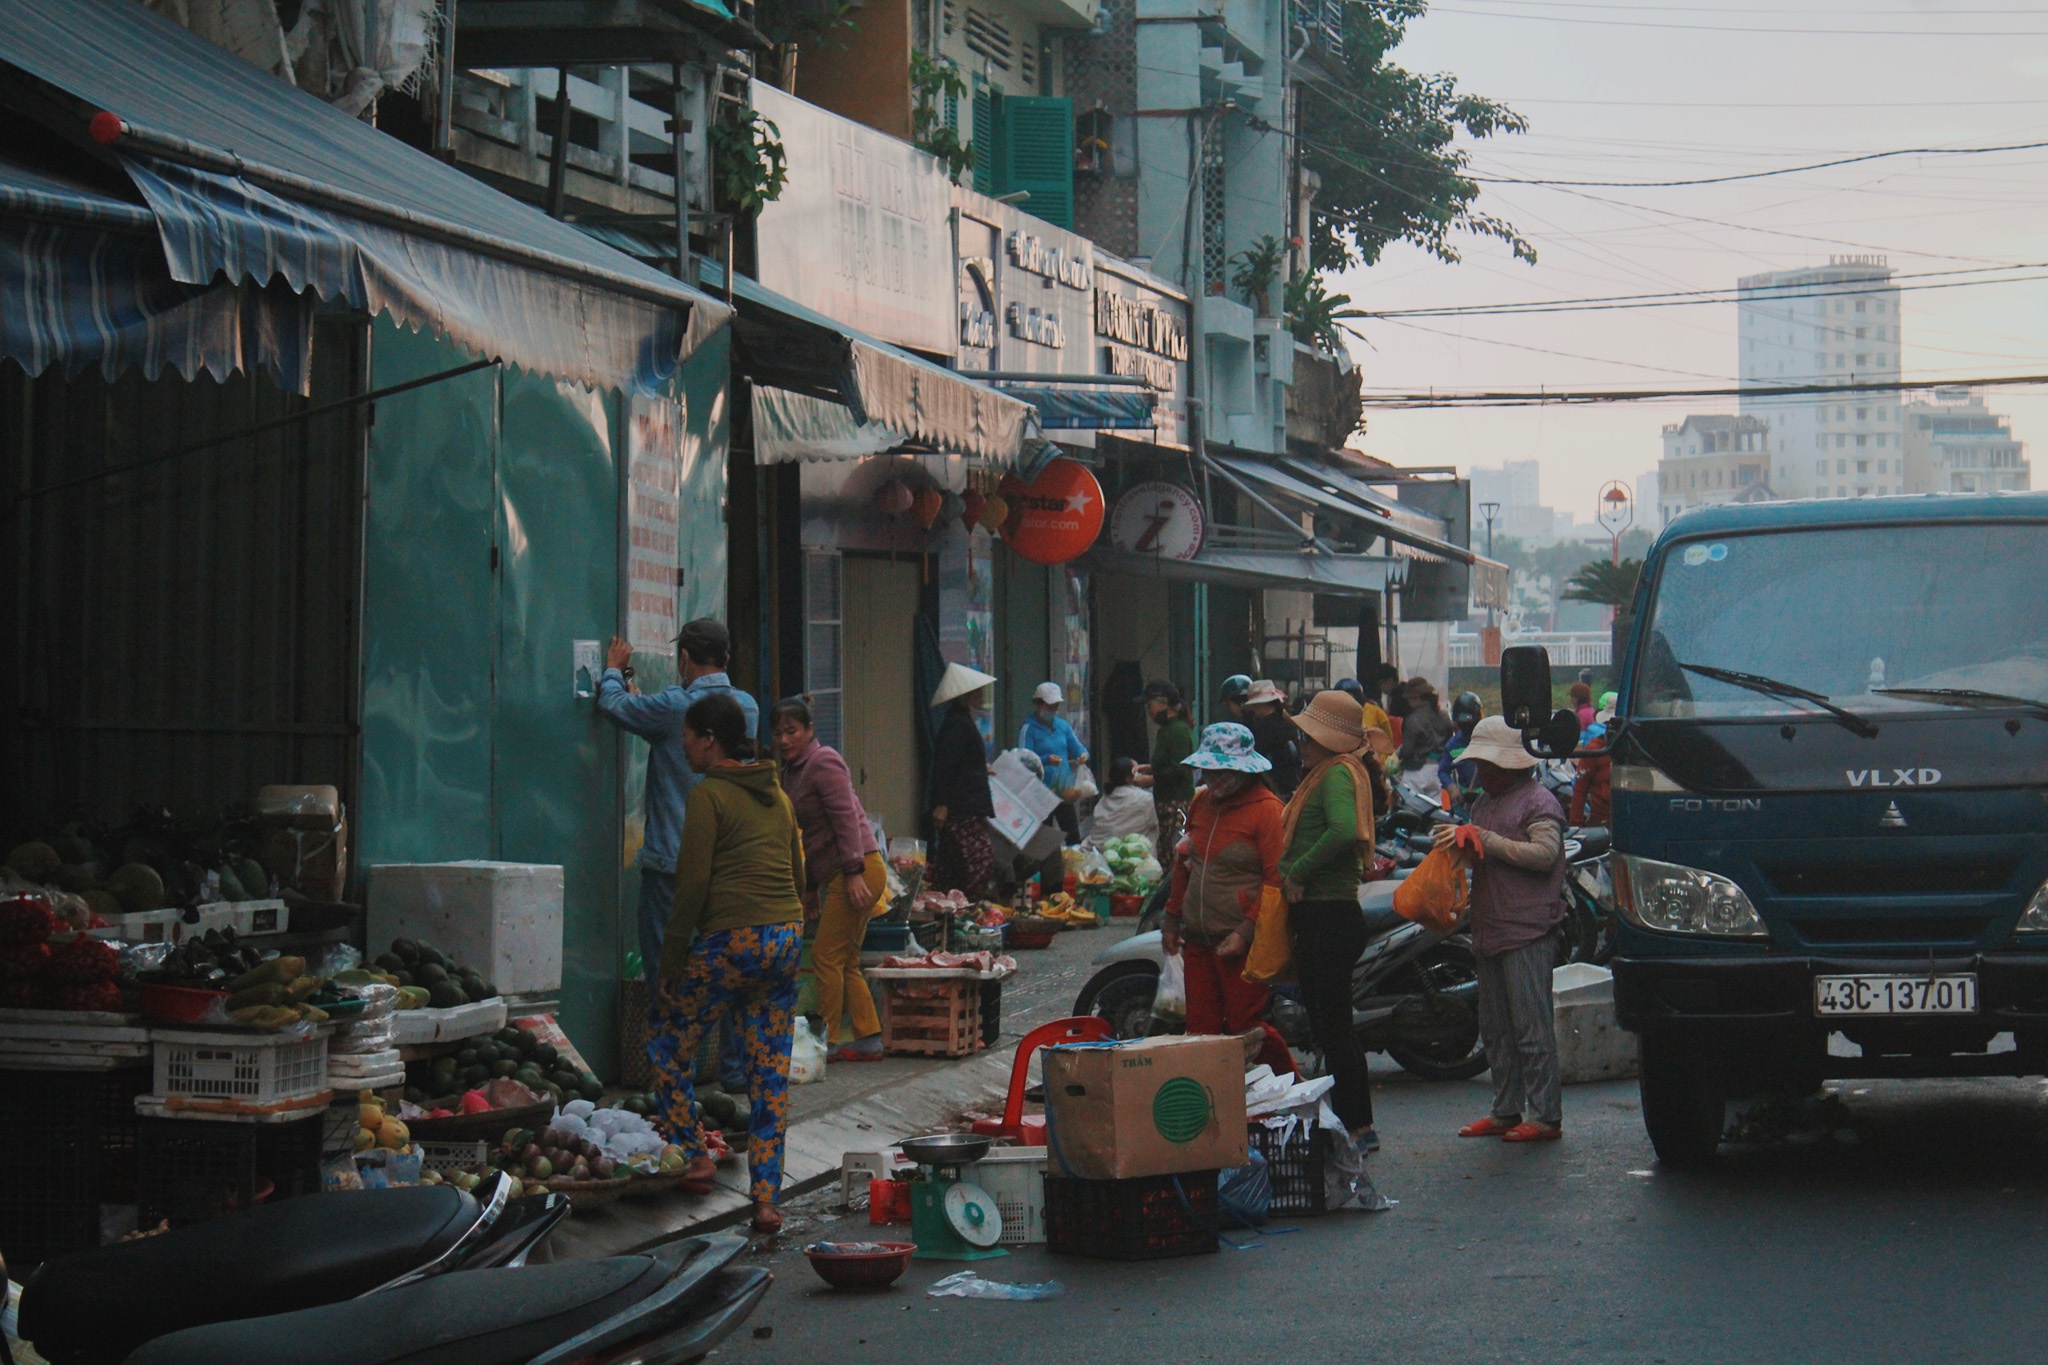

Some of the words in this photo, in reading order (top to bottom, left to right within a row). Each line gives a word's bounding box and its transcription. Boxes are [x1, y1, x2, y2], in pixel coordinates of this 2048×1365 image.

[1095, 288, 1149, 348] BOOKING
[1846, 768, 1942, 786] VLXD
[1669, 798, 1761, 811] FOTON
[1822, 981, 1966, 1010] 43C-137.01
